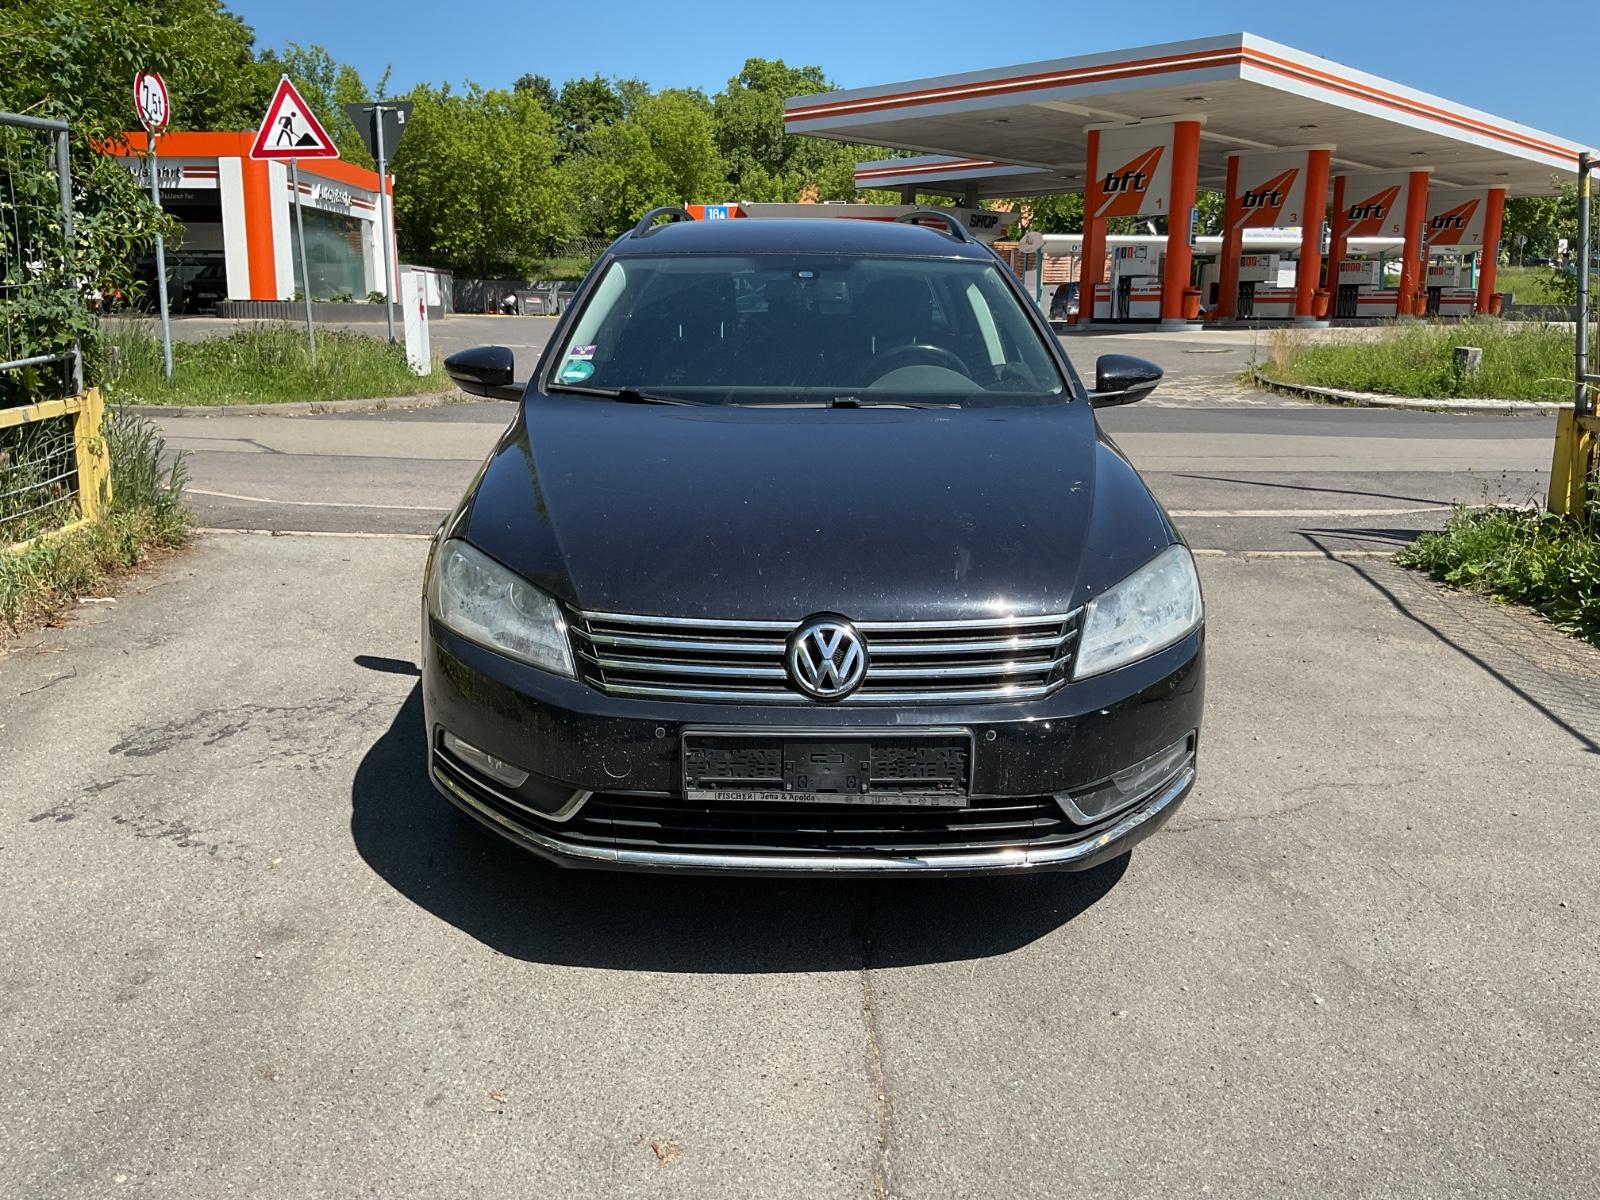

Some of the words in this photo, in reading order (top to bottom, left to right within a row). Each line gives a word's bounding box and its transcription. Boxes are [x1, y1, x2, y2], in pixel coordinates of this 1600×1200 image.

[125, 165, 181, 178] Ausahrt
[1103, 170, 1147, 194] bft
[1155, 198, 1162, 209] 1
[1241, 190, 1283, 209] bft
[1289, 213, 1298, 223] 3
[1348, 204, 1387, 221] bft
[969, 214, 998, 229] SHOP
[1393, 224, 1400, 233] 5
[1431, 215, 1465, 230] bft
[1472, 233, 1479, 241] 7
[793, 623, 866, 694] VW
[717, 792, 752, 800] FISCHER
[760, 792, 779, 800] Jena
[781, 792, 787, 800] &
[788, 793, 816, 802] Apolda
